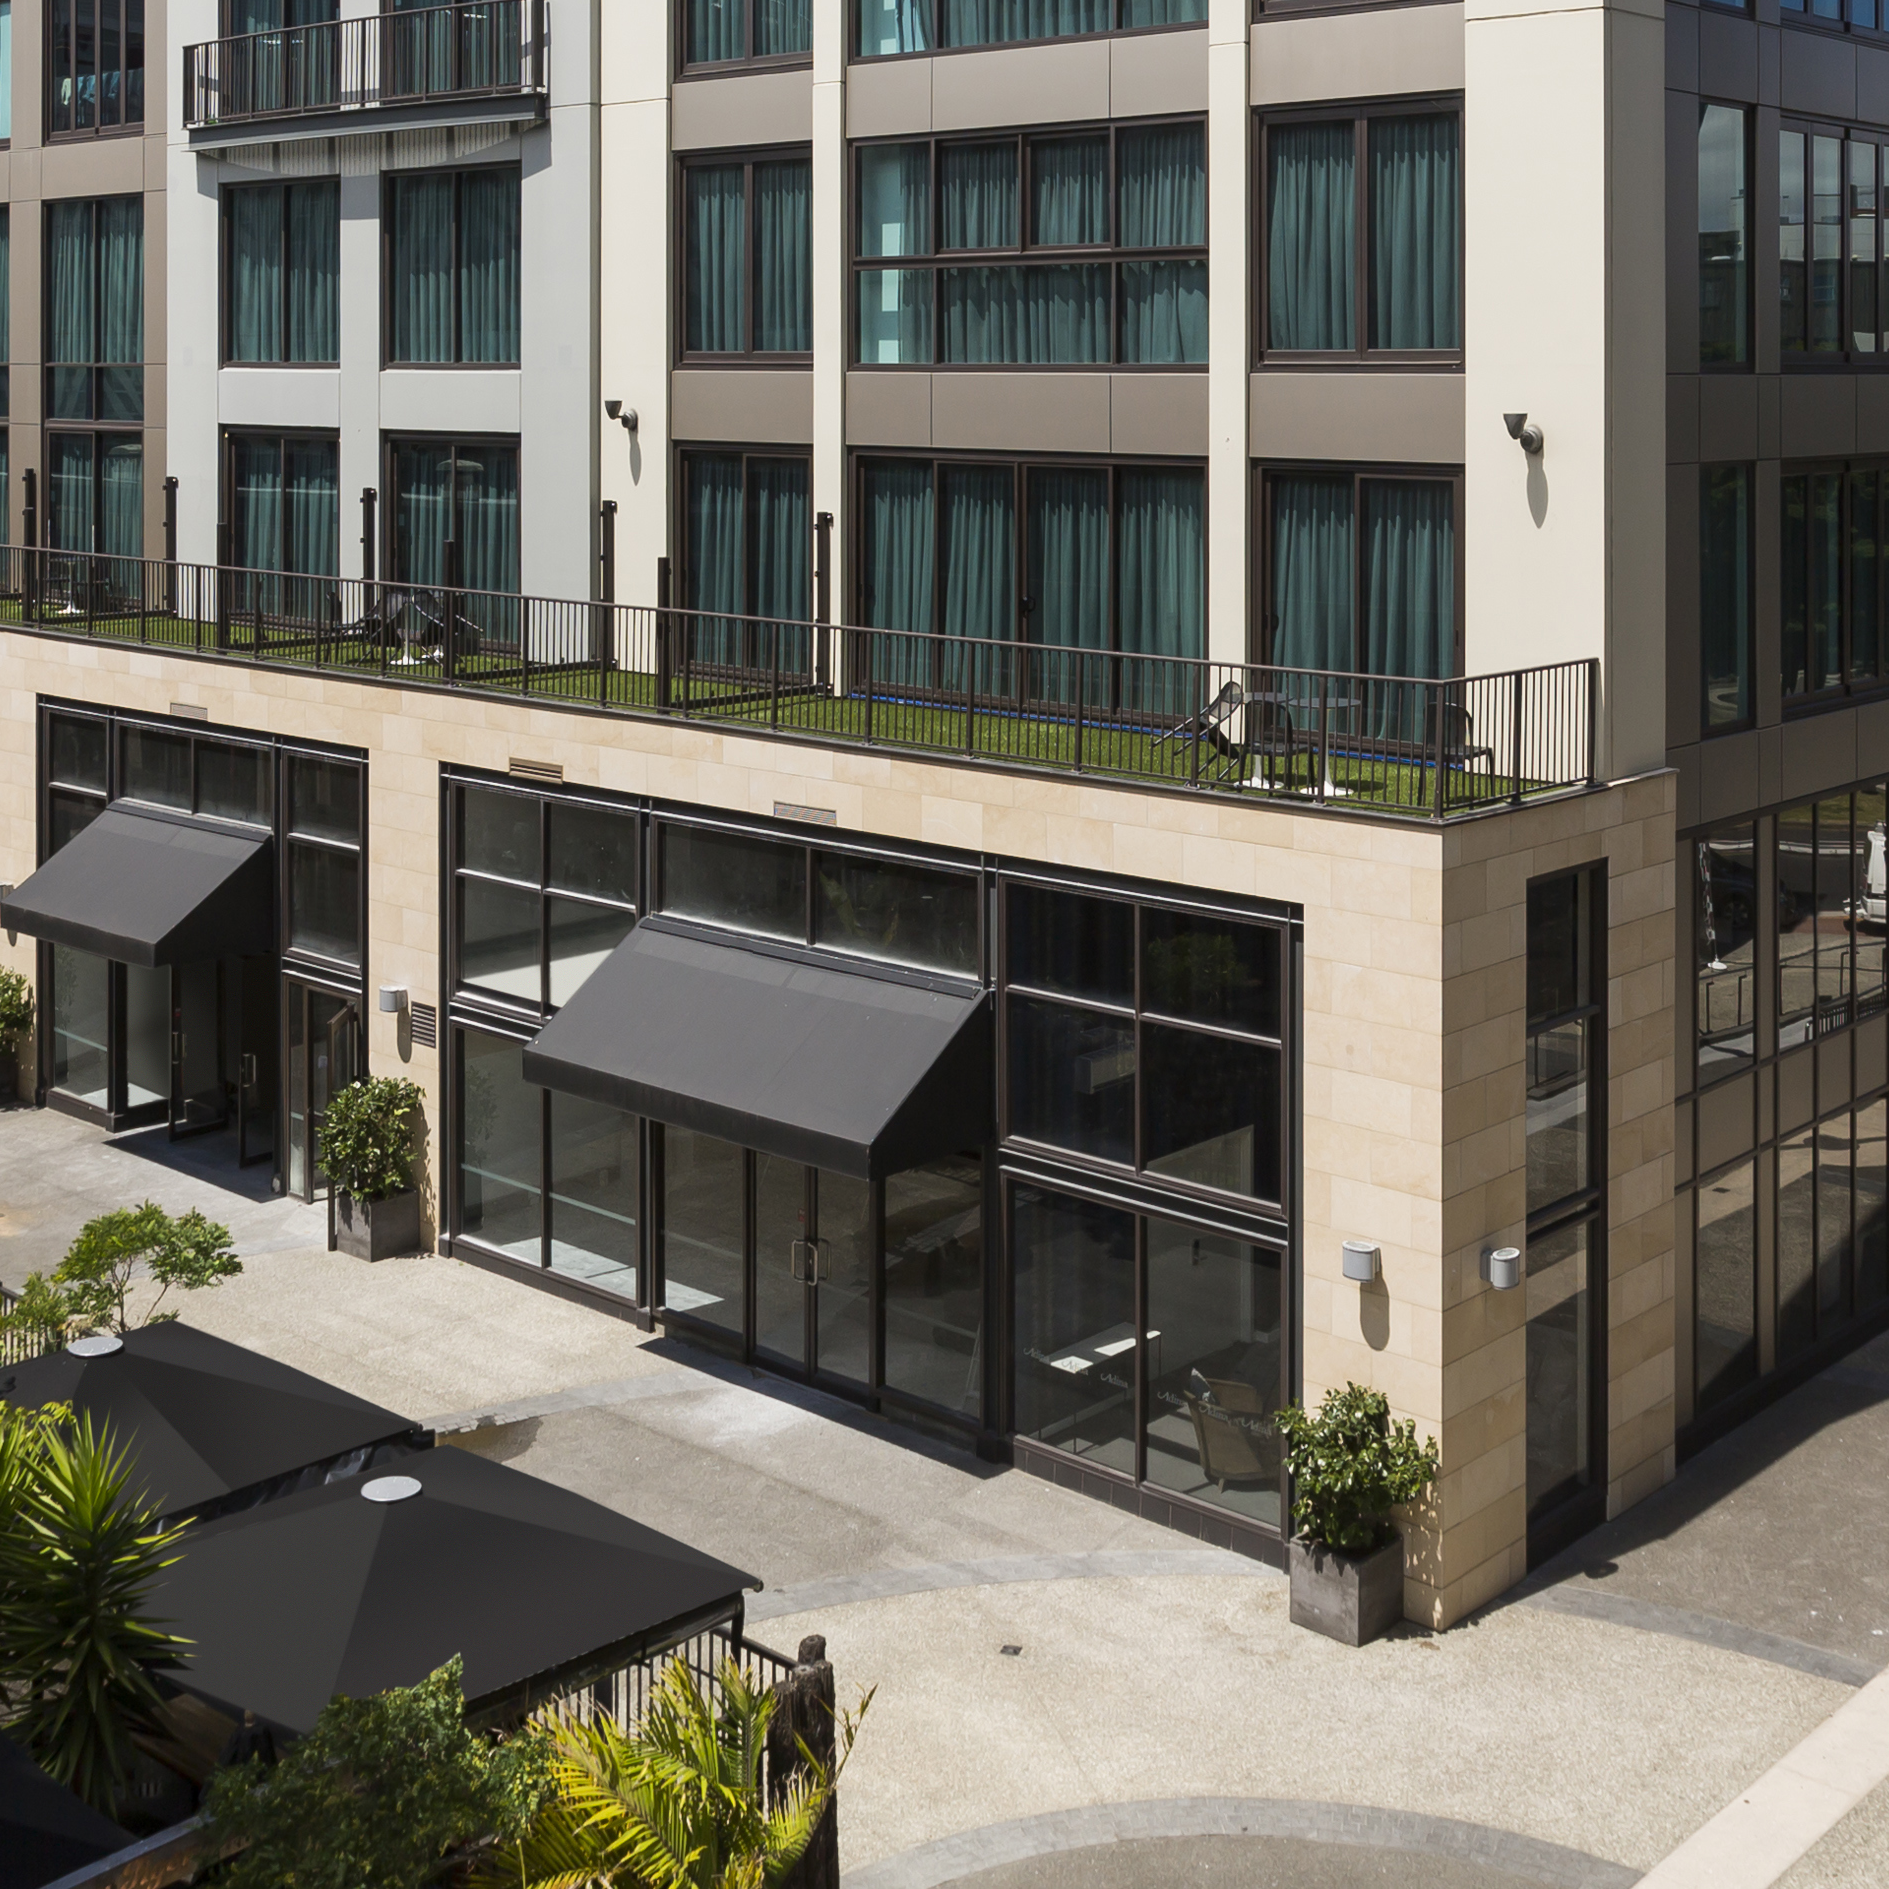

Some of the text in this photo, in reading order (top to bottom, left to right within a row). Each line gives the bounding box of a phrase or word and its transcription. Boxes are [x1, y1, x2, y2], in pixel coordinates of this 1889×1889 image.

[1100, 1372, 1129, 1389] Adina
[1157, 1391, 1188, 1408] Adina
[1198, 1404, 1229, 1422] Adina
